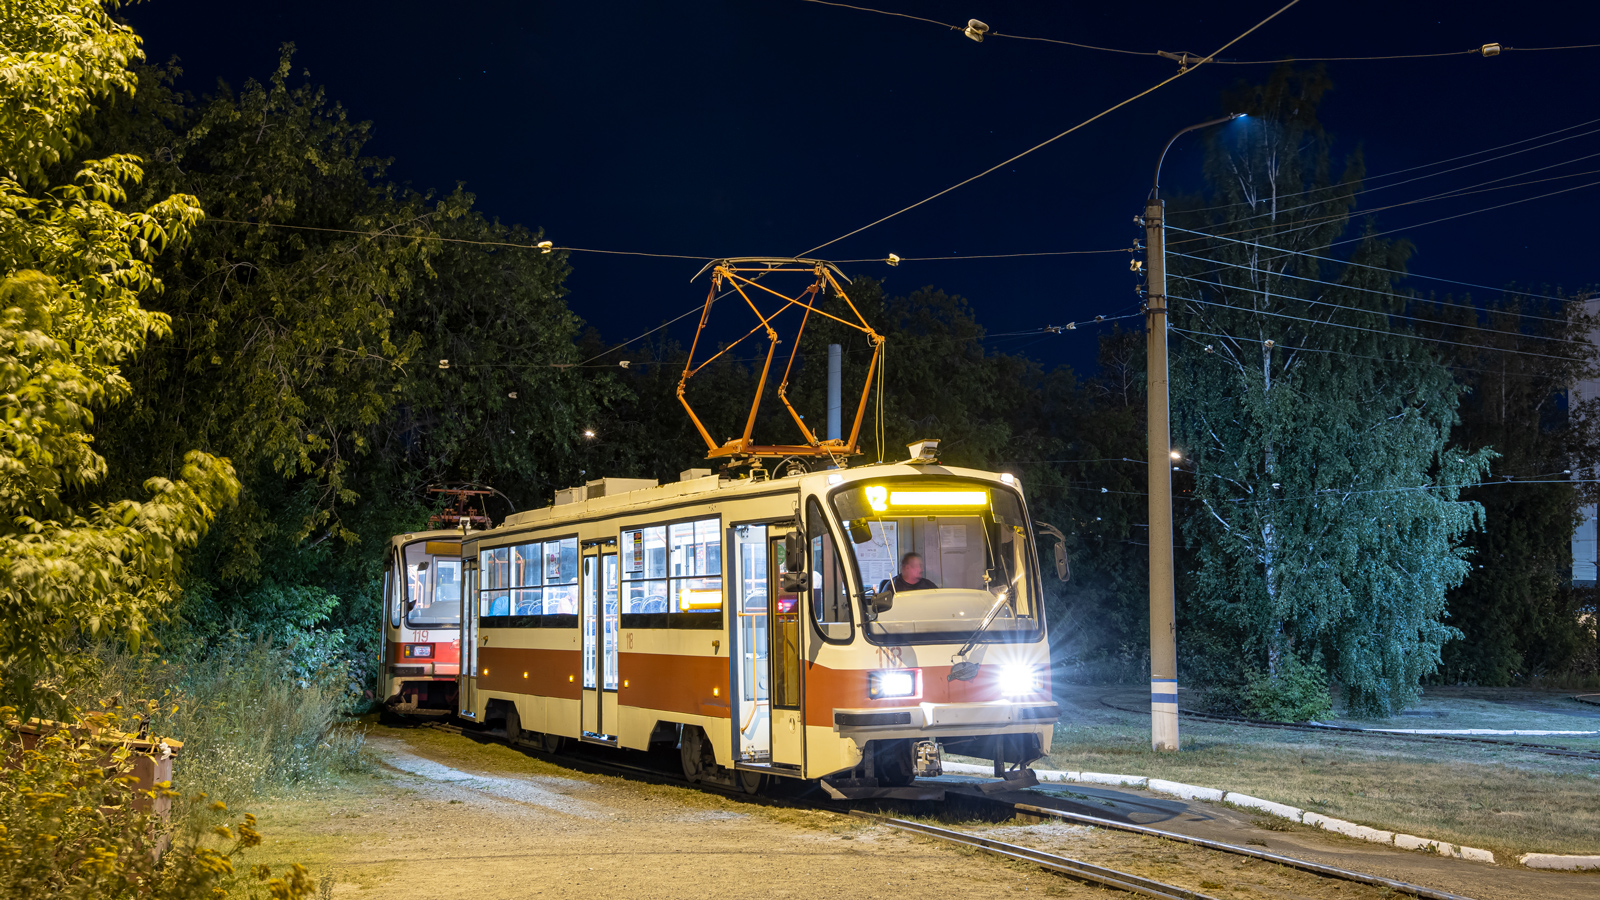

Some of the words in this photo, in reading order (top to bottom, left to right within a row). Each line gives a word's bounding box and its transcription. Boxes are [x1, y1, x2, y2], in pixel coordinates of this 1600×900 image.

[412, 630, 429, 643] 119
[626, 632, 634, 650] 118
[875, 646, 903, 668] 118
